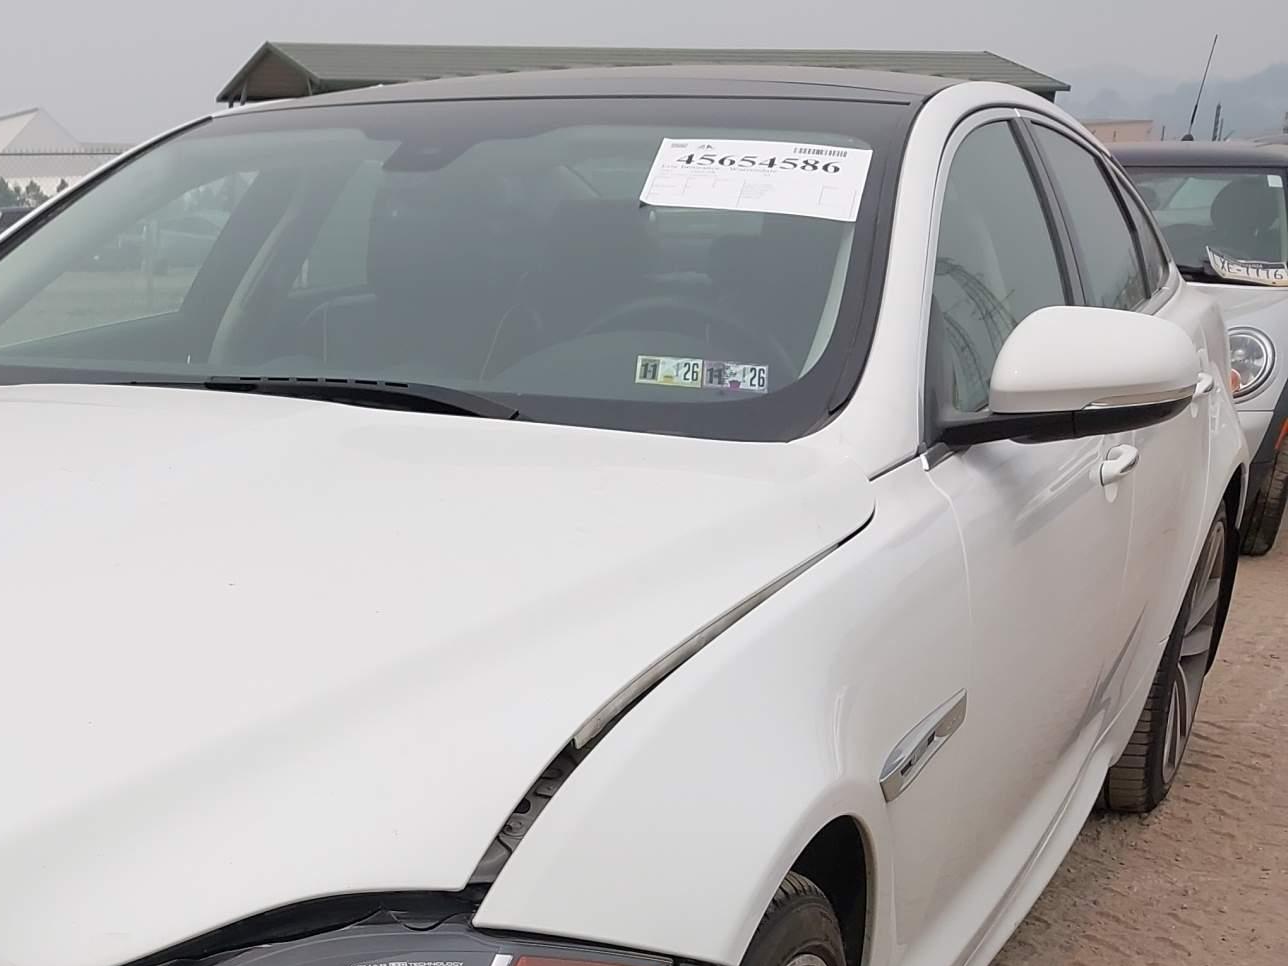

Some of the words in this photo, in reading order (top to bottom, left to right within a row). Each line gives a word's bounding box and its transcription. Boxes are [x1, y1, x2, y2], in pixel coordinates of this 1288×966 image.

[676, 153, 841, 174] 45654586
[683, 362, 699, 381] 26
[750, 367, 765, 387] 26
